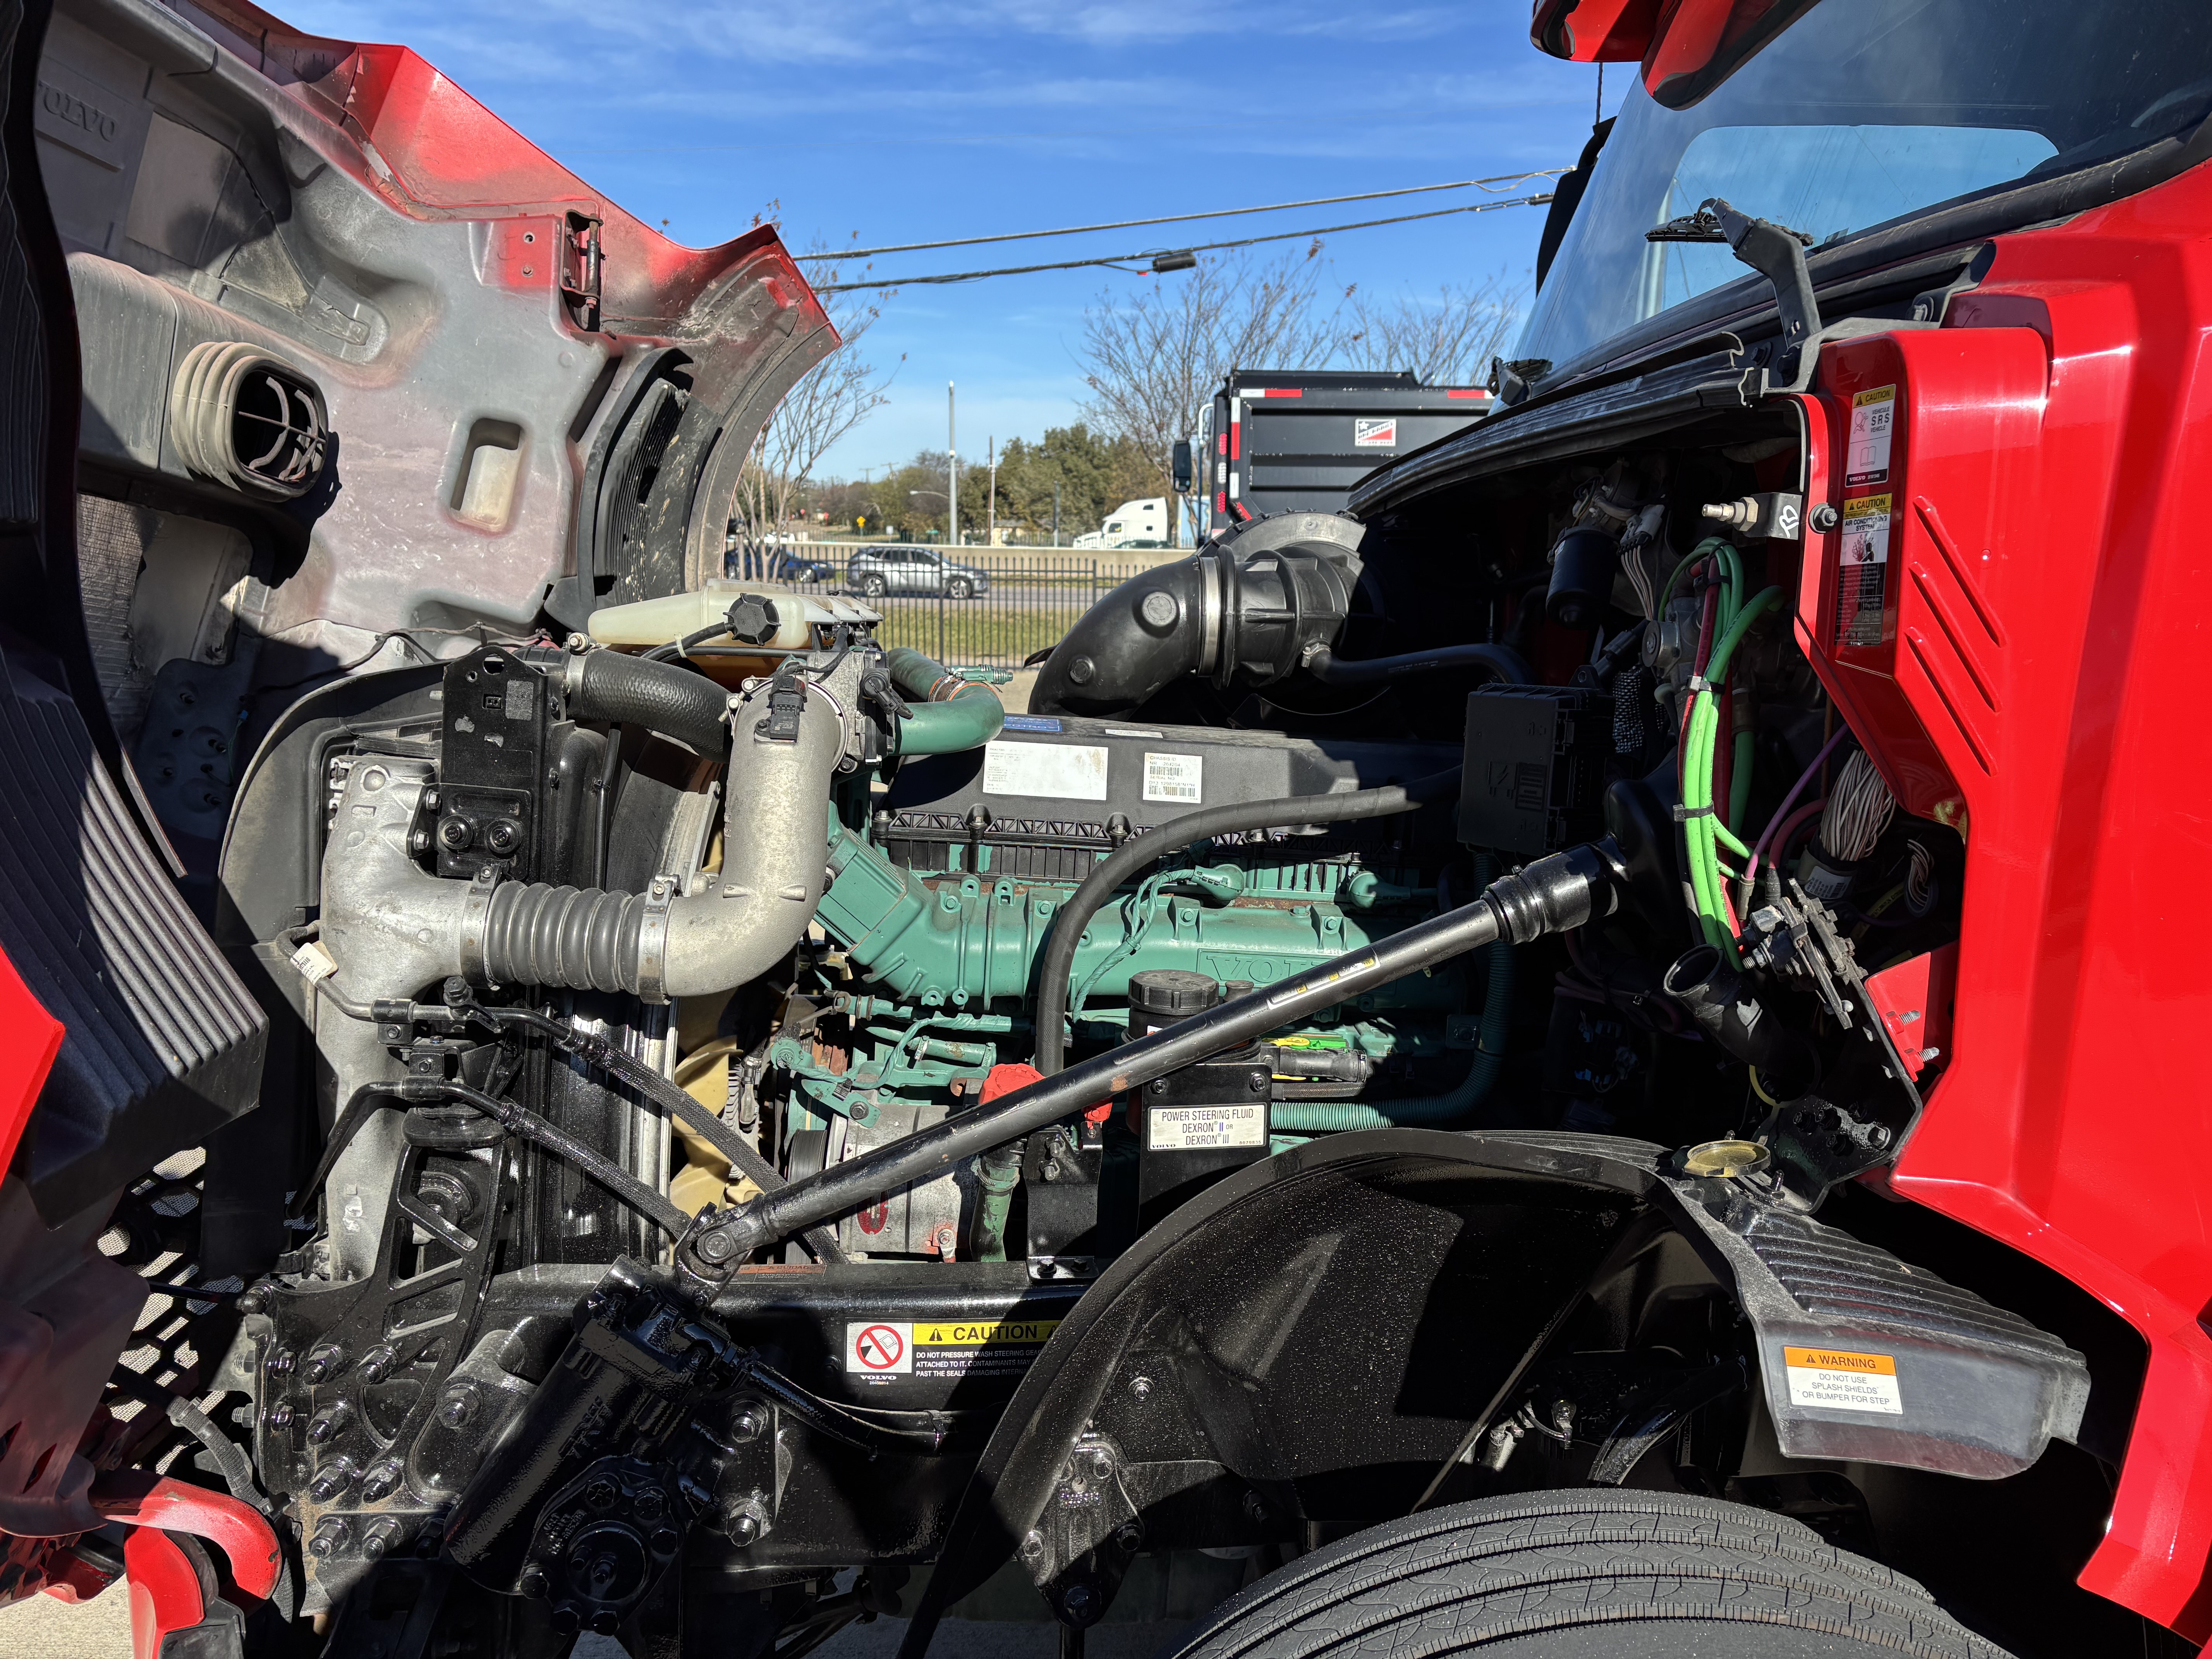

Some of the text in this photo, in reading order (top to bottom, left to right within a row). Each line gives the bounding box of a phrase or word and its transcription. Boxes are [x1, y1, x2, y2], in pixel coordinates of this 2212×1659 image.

[38, 81, 116, 143] OLVO
[1866, 390, 1891, 402] CAUTION
[1856, 498, 1886, 509] CAUTION
[1162, 1109, 1253, 1122] POWER STEERING FLUID
[1219, 1122, 1223, 1132] II
[953, 1325, 1037, 1341] CAUTION
[1819, 1354, 1876, 1369] WARNING
[1851, 1376, 1867, 1384] USE
[1812, 1382, 1877, 1394] SPLASH SHIELDS
[1817, 1393, 1850, 1401] BUMPER
[1852, 1395, 1868, 1403] FOR
[1870, 1397, 1889, 1405] STEP
